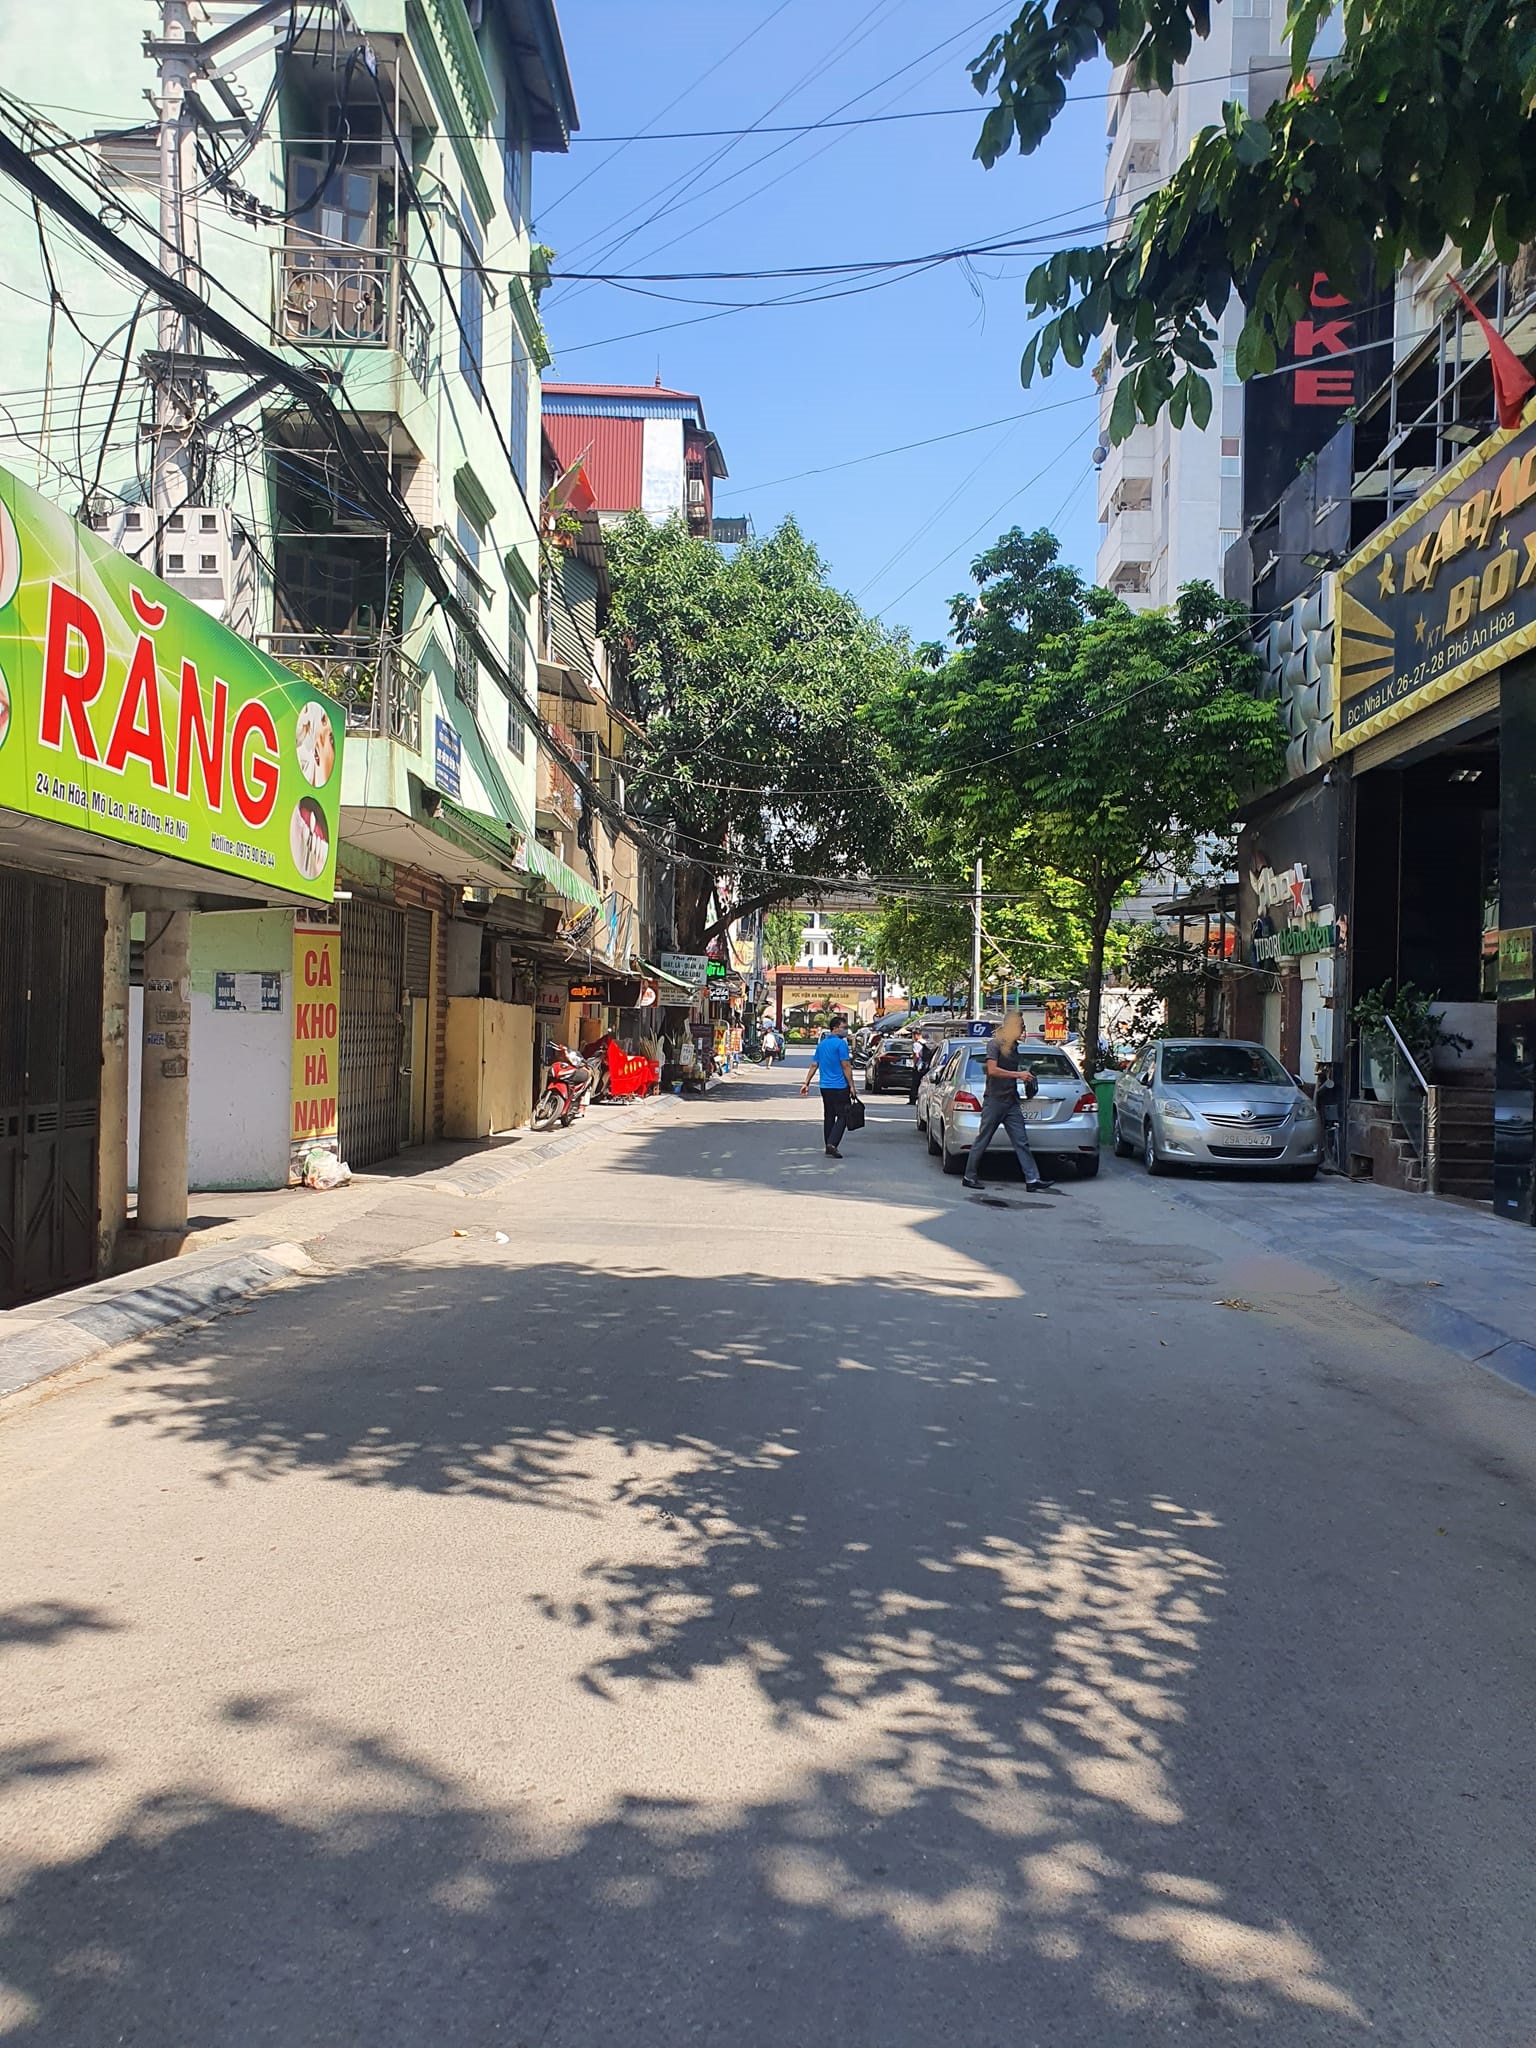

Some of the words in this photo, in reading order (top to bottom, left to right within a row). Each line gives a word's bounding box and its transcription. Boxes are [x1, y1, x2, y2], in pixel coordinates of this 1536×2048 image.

[1364, 690, 1381, 715] Nhà
[1381, 682, 1394, 704] LK
[1396, 651, 1444, 695] 26-27-28
[1447, 631, 1468, 665] Phố
[1471, 630, 1487, 650] An
[1489, 610, 1515, 640] Hòa
[39, 577, 280, 828] RĂNG
[35, 773, 49, 795] 24
[52, 778, 65, 800] An
[67, 783, 89, 810] Hòa,
[91, 791, 106, 818] Mộ
[108, 797, 126, 822] Lao,
[128, 804, 139, 825] Hà
[164, 817, 174, 836] Hà
[175, 819, 188, 843] Nội
[211, 832, 235, 856] Hotline:
[235, 841, 251, 861] 0975
[1254, 932, 1281, 963] TUBOR
[1280, 922, 1330, 955] Heineken
[304, 943, 332, 987] CÁ
[295, 1003, 337, 1040] KHO
[304, 1047, 328, 1086] HÀ
[294, 1098, 336, 1132] NAM
